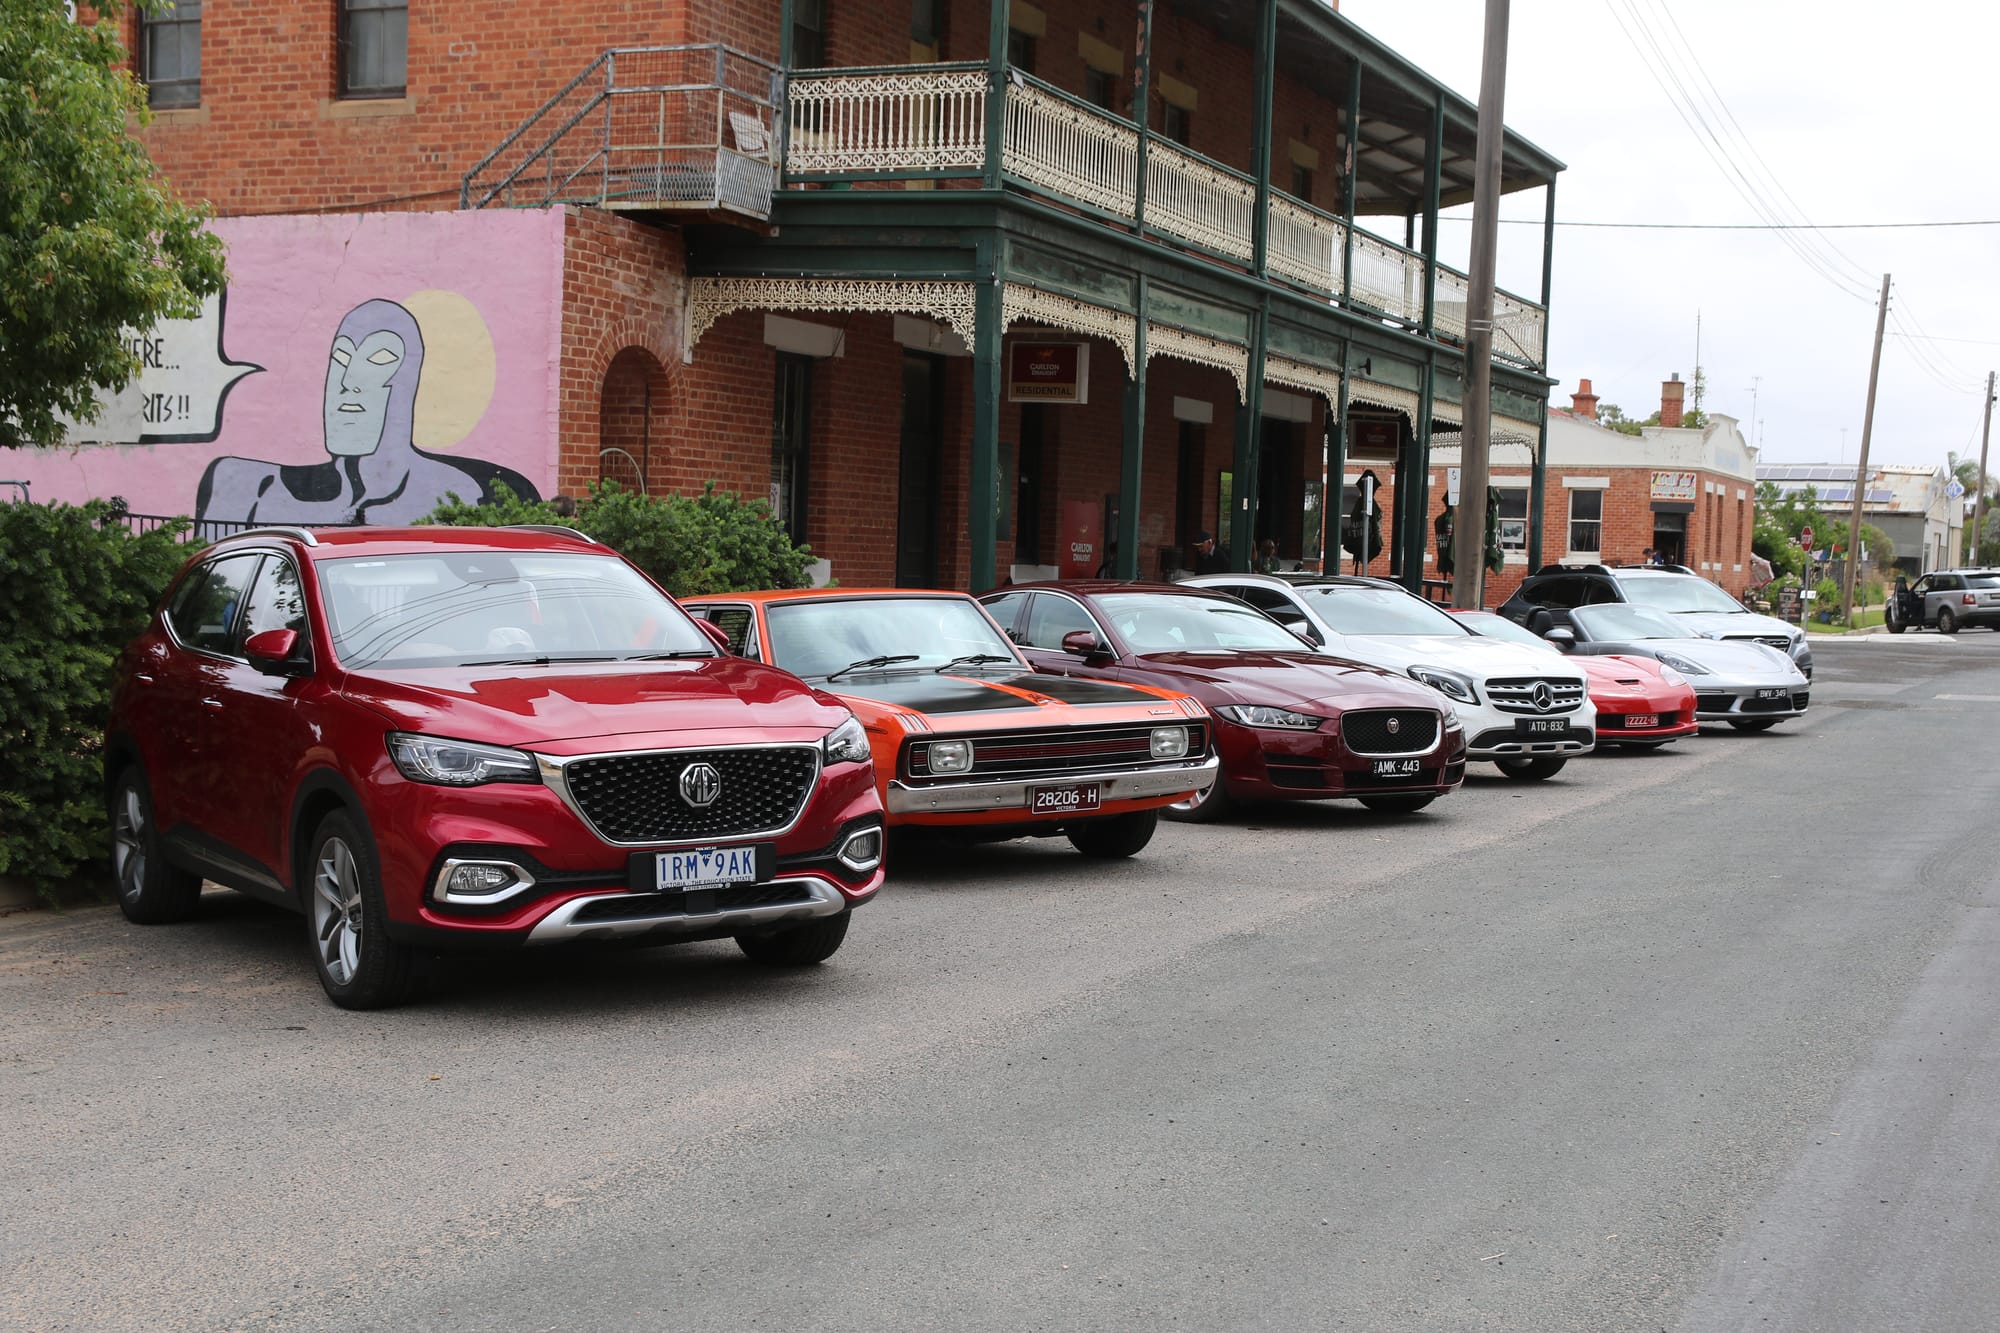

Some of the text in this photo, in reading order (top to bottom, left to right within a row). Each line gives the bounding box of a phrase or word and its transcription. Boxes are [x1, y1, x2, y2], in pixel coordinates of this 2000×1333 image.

[1015, 385, 1073, 396] RESIDENTIAL
[1071, 542, 1093, 553] CARLTON
[685, 766, 718, 802] MG
[660, 849, 753, 881] 1RM 9AK
[660, 881, 687, 889] VICTORIA
